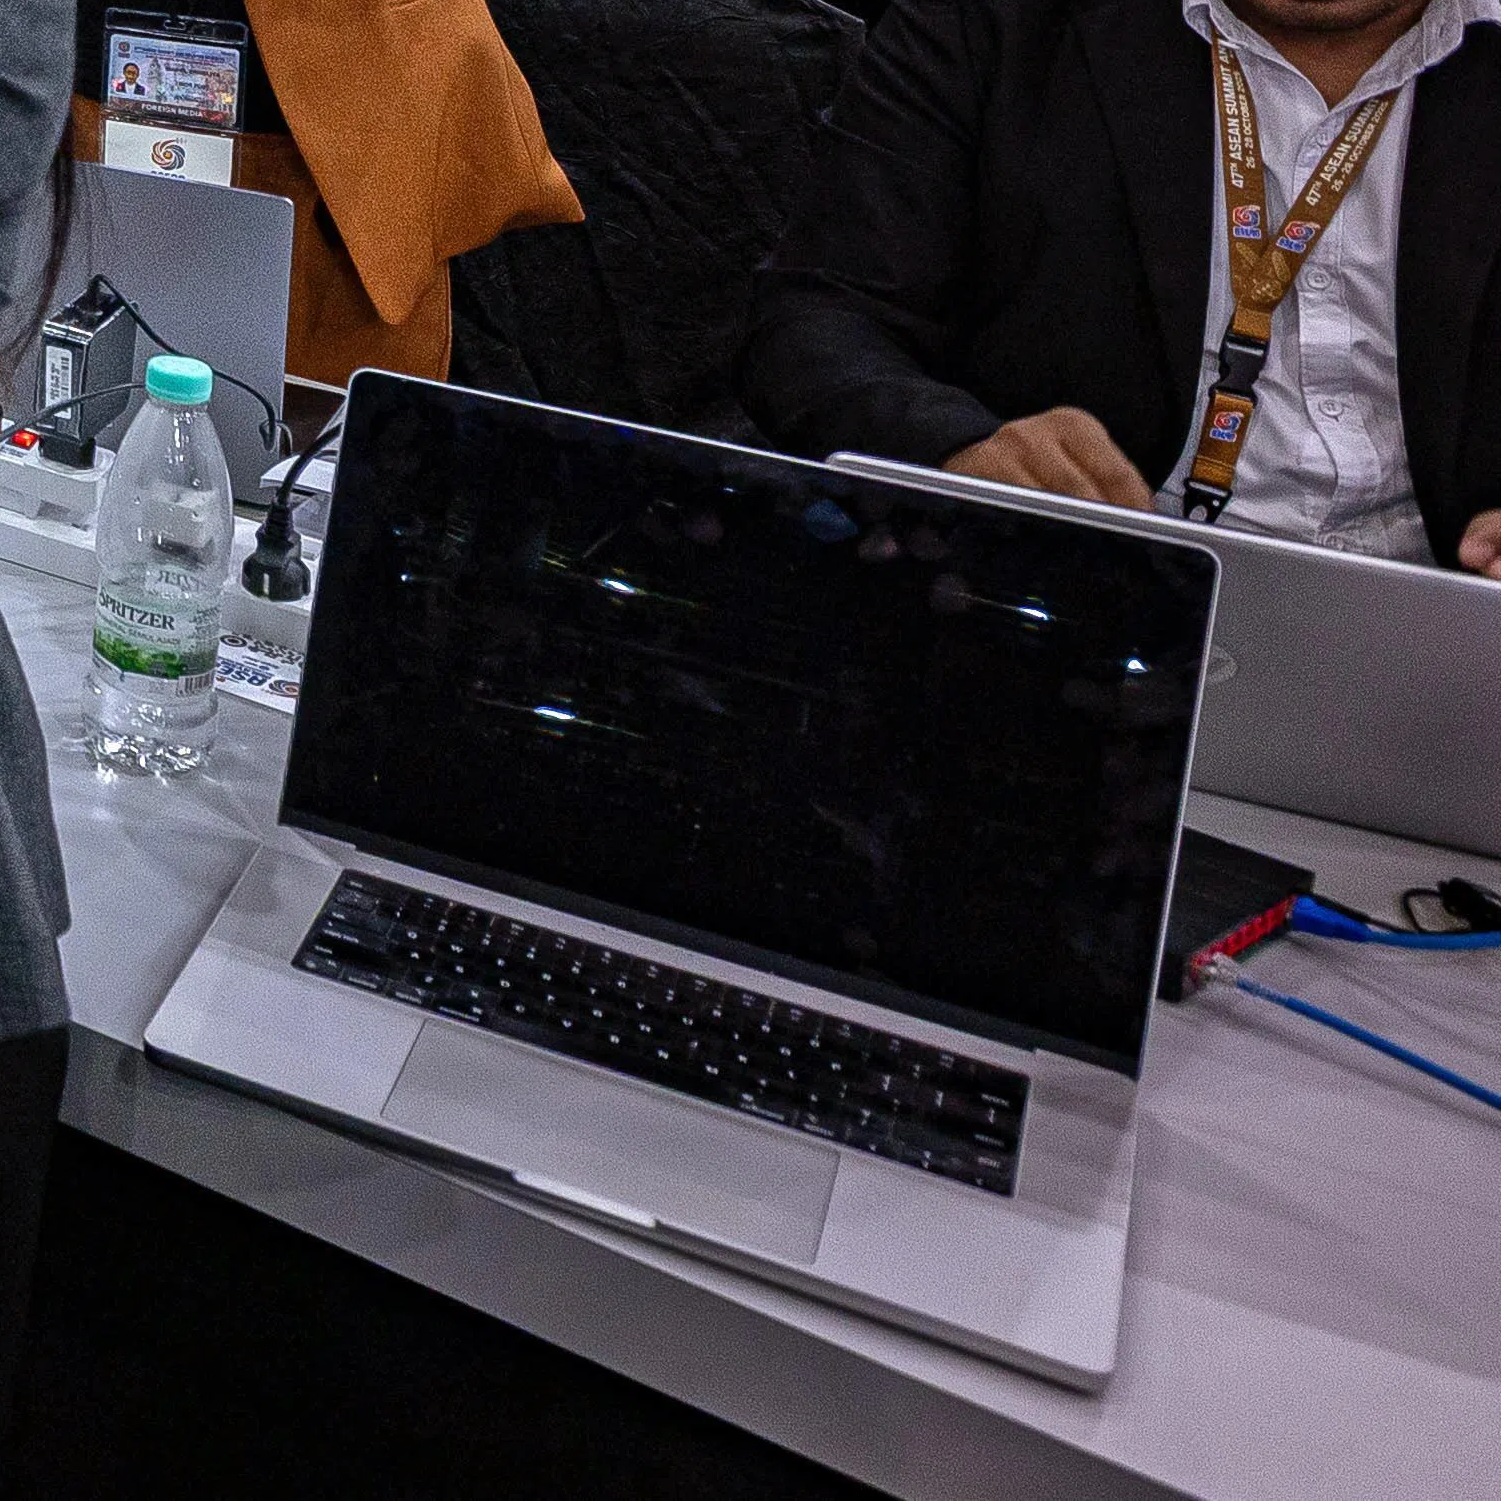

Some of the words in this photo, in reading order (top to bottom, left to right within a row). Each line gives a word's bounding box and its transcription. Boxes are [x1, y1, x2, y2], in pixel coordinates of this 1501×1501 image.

[141, 103, 177, 115] FOREIGN
[178, 106, 203, 117] MEDIA
[1220, 64, 1237, 115] SUMMIT
[1238, 93, 1252, 135] OCTOBER
[1226, 118, 1242, 161] ASEAN
[1305, 180, 1326, 206] 47TH
[1320, 141, 1351, 181] ASEAN
[1344, 96, 1380, 143] SUMMIT
[1347, 123, 1377, 162] OCTOBER
[1229, 161, 1244, 188] 47TH
[99, 585, 175, 631] SPRITZER
